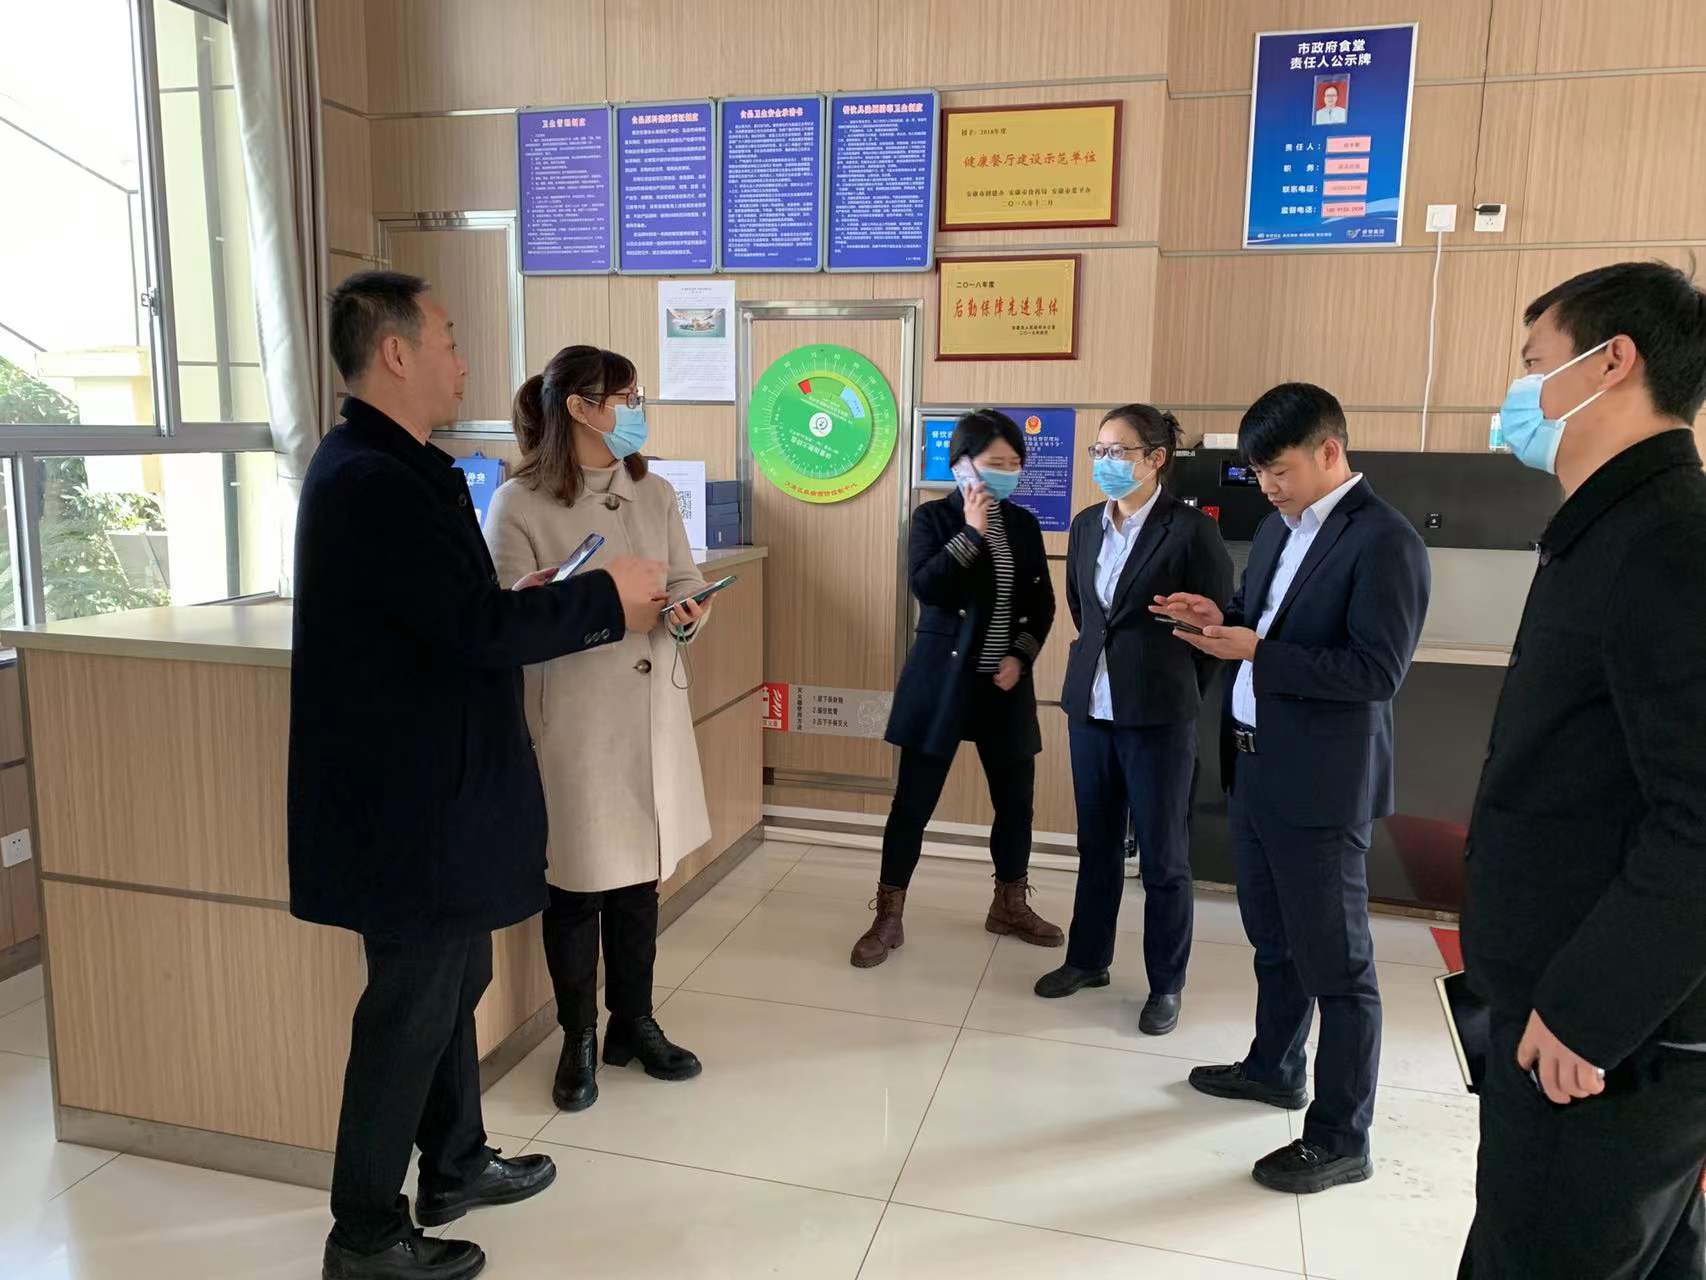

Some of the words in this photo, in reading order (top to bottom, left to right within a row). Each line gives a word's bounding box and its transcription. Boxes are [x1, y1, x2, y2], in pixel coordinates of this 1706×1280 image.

[1298, 39, 1366, 55] 市政府食堂
[1290, 53, 1372, 70] 责任人公示牌
[962, 150, 1097, 168] 健康餐厅建设示范单位
[954, 295, 1058, 318] 后勤保障先进集体
